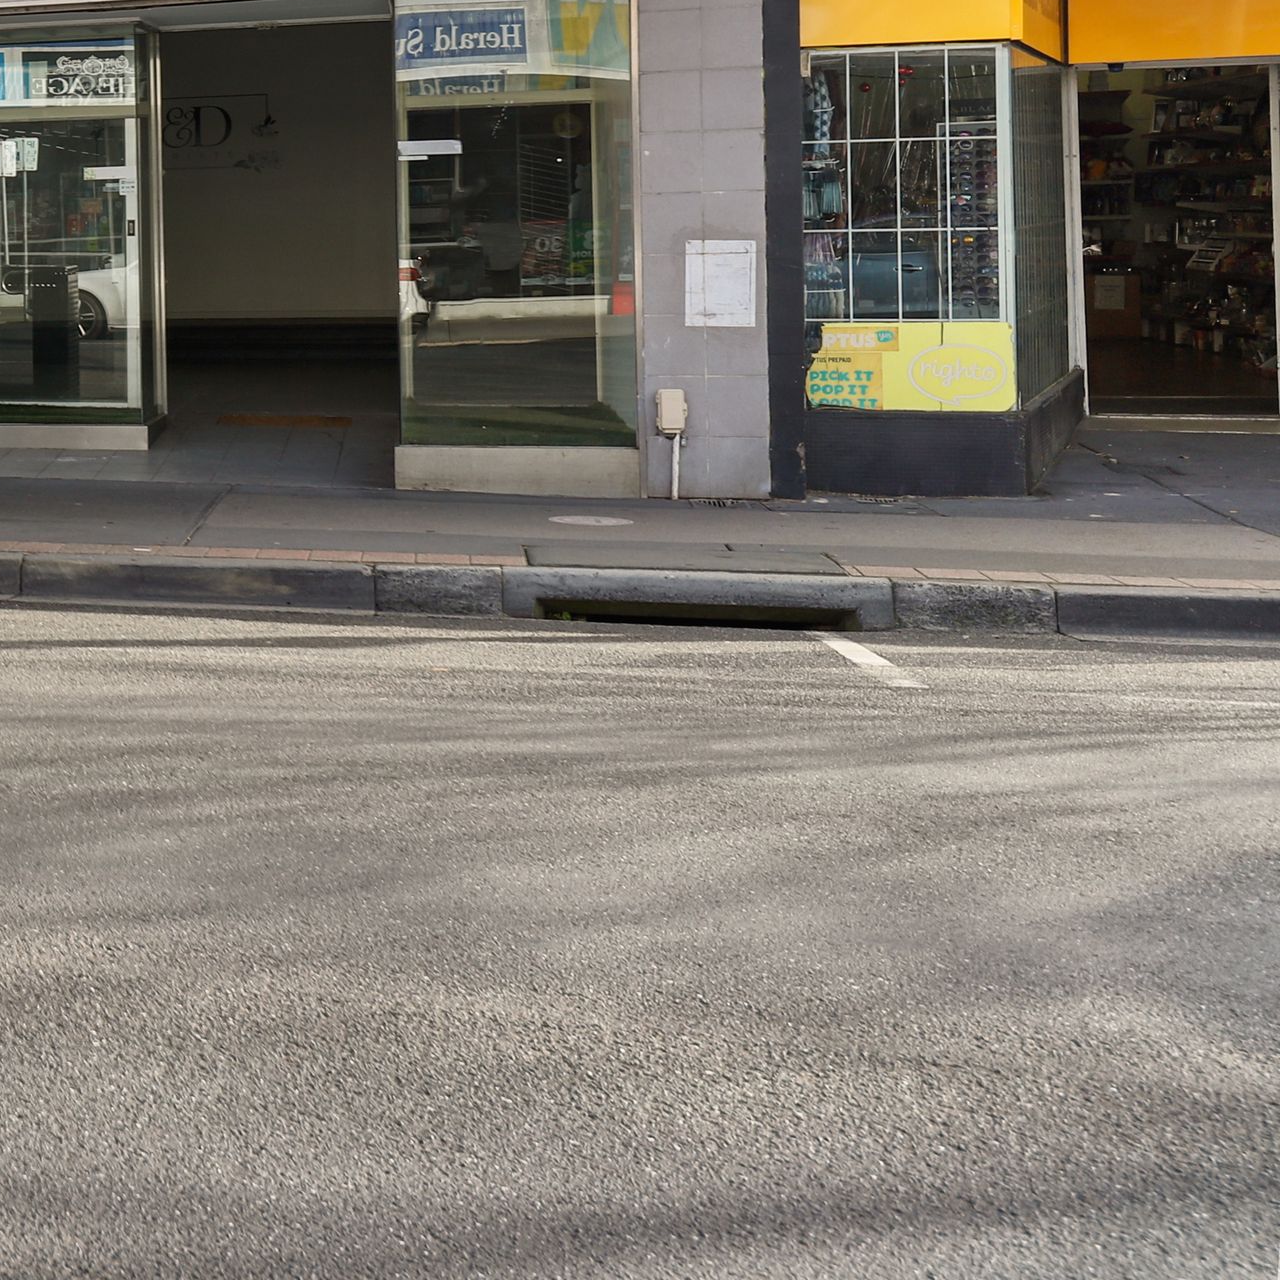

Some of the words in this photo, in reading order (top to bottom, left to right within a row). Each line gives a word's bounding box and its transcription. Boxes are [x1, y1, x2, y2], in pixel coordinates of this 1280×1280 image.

[162, 105, 232, 148] &D
[823, 333, 876, 348] PTUS
[810, 371, 850, 382] PICK
[855, 371, 874, 382] IT
[920, 359, 997, 387] righto
[810, 384, 844, 395] POP
[848, 384, 869, 395] IT
